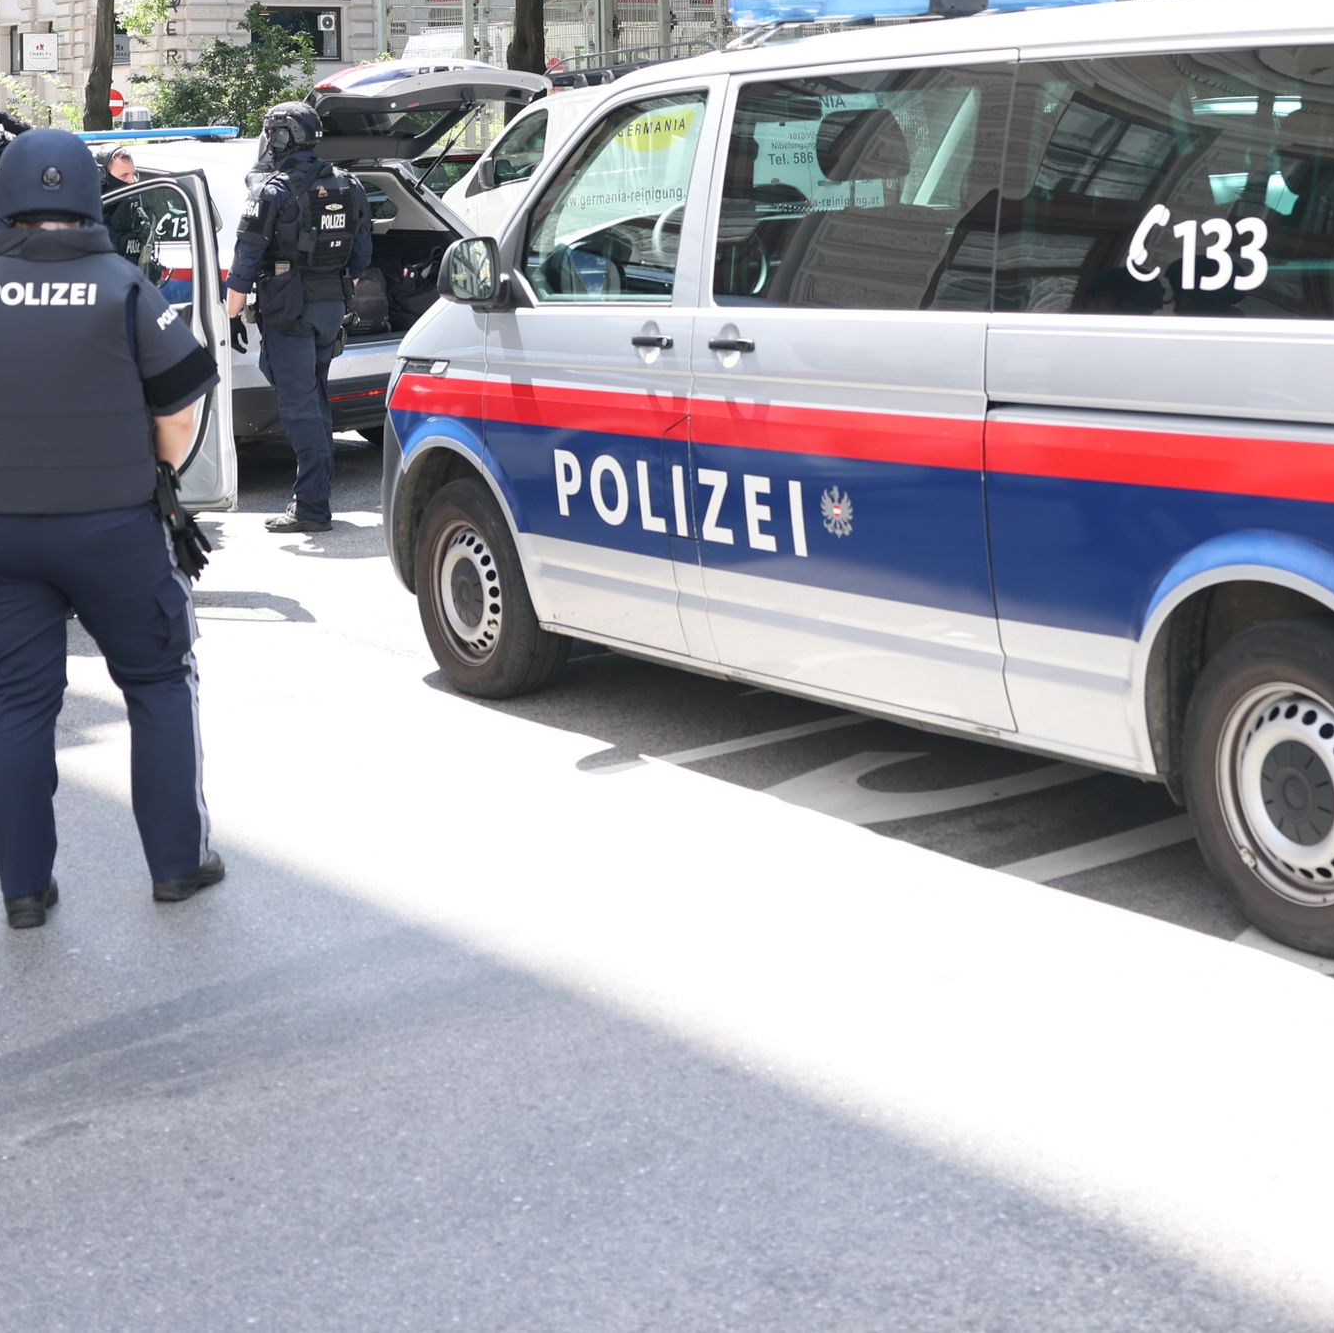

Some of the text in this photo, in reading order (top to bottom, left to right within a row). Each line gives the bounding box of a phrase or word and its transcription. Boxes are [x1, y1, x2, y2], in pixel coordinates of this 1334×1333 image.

[767, 151, 814, 166] Tel. 586
[171, 216, 190, 238] 13
[320, 213, 346, 230] POLIZEI
[1172, 216, 1269, 292] 133
[553, 448, 808, 558] POLIZEI
